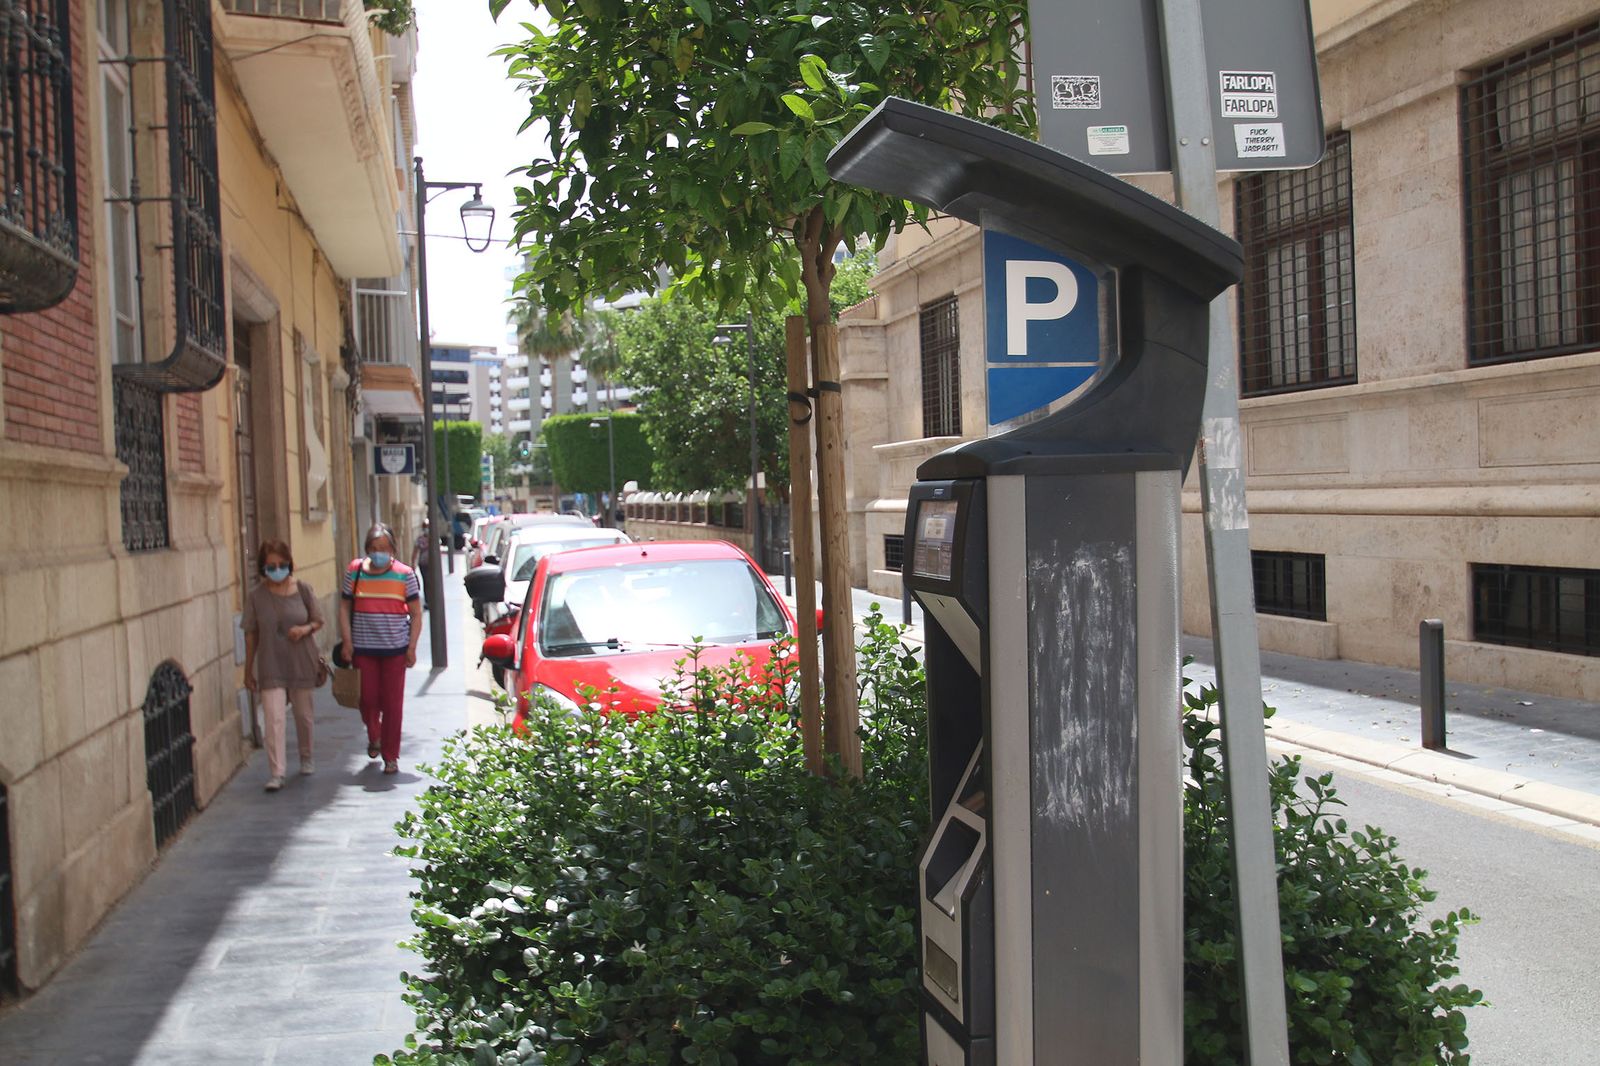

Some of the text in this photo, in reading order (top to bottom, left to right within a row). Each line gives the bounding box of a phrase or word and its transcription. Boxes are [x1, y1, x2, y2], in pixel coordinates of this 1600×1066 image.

[1223, 76, 1273, 90] FARLOPA
[1224, 99, 1275, 112] FARLOPA
[1249, 128, 1268, 136] FUCK
[1005, 259, 1078, 356] P
